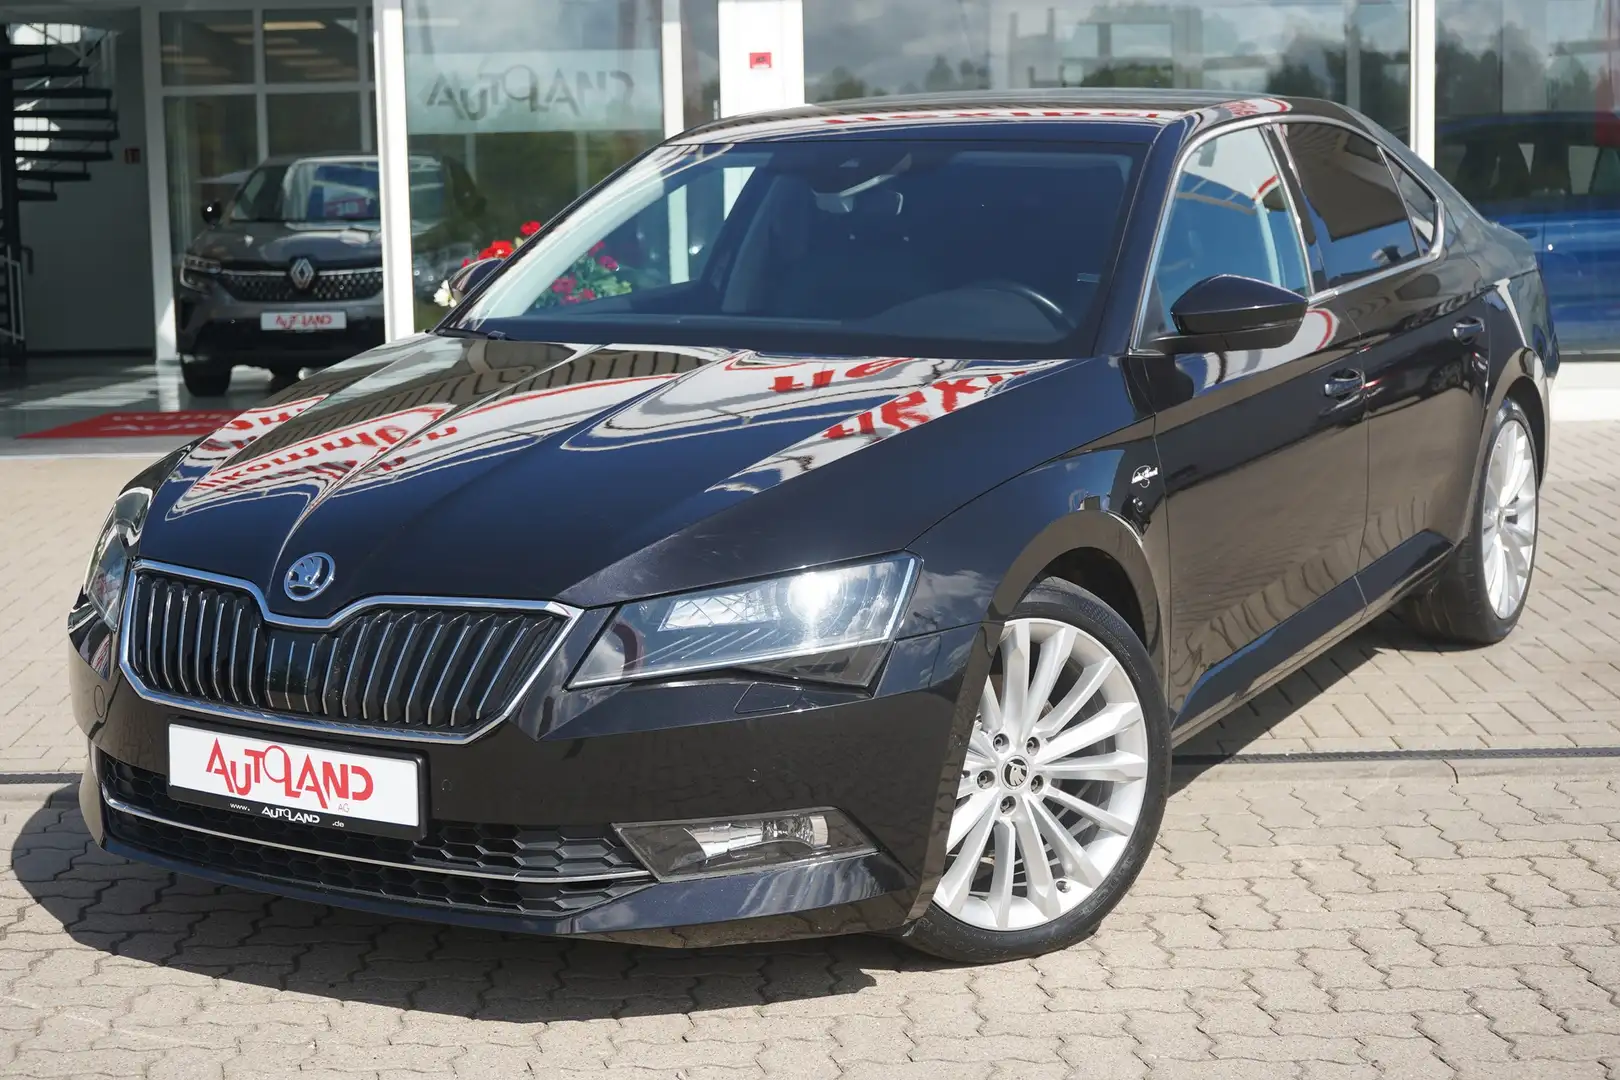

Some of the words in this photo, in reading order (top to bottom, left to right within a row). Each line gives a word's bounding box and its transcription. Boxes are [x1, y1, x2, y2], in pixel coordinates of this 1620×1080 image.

[276, 314, 332, 328] AUTLAND
[206, 737, 374, 809] AUTOLAND
[338, 802, 350, 813] AG
